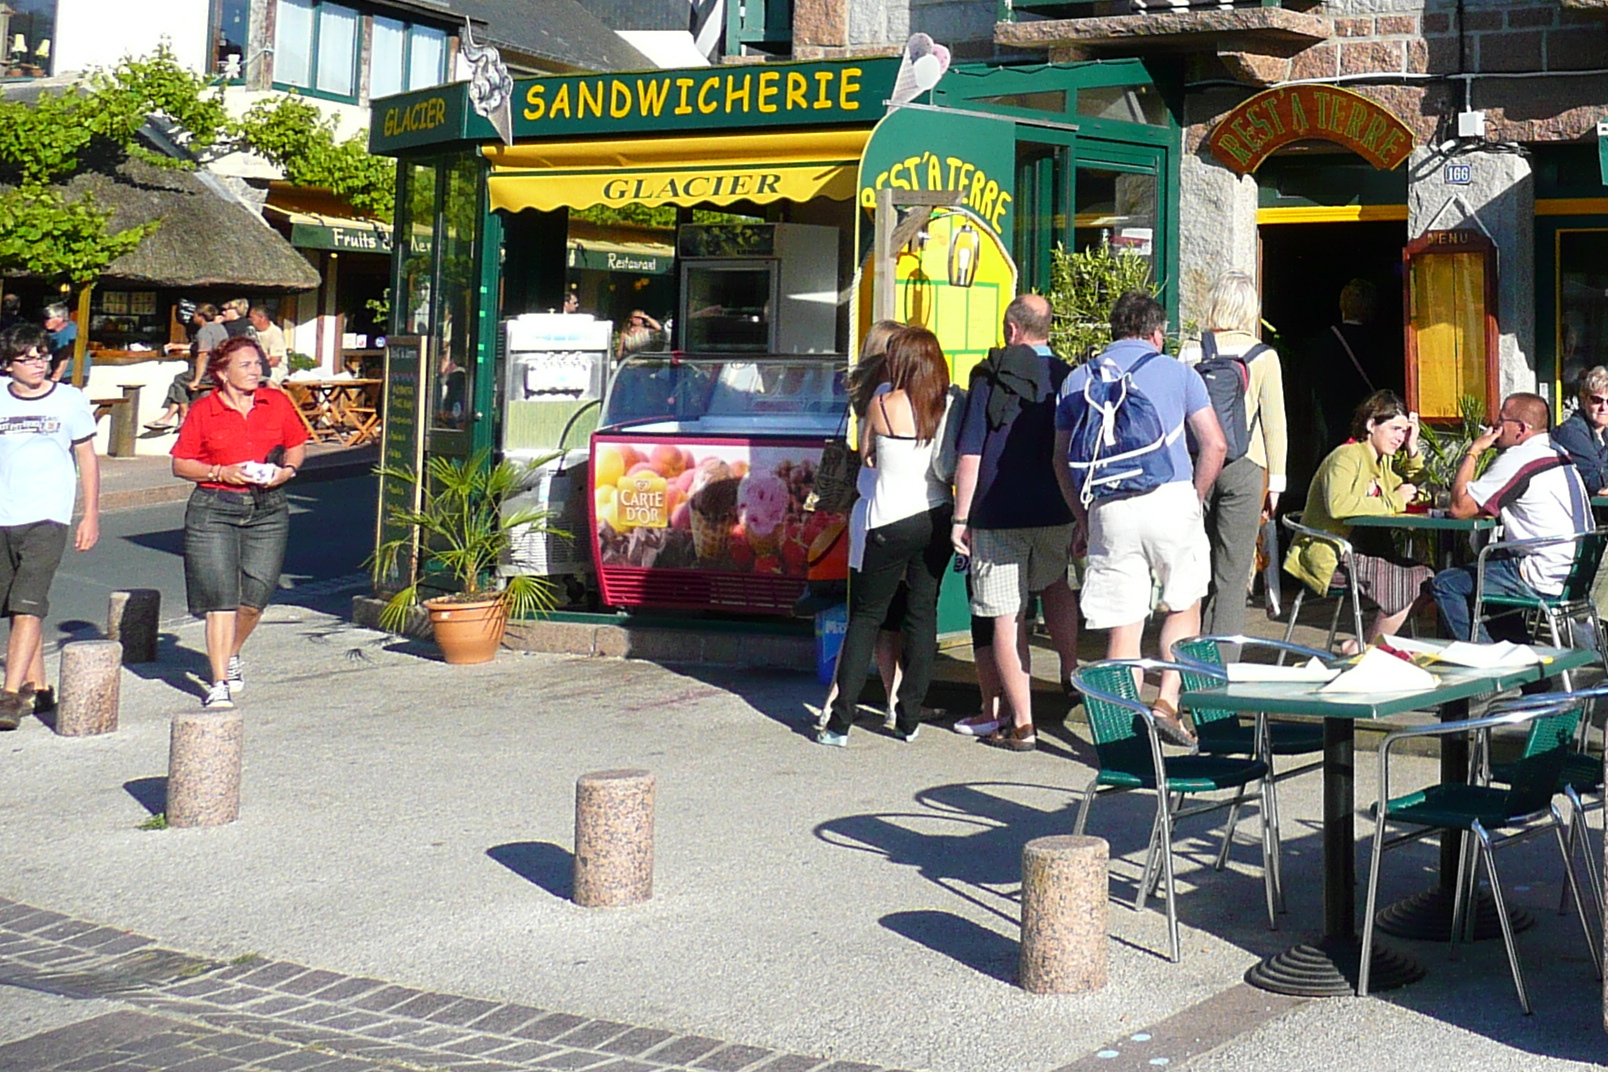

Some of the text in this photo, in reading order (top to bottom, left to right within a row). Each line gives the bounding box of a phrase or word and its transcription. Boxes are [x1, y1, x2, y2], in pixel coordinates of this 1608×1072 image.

[522, 67, 863, 121] SANDWICHERIE
[383, 97, 446, 138] GLACIER
[1218, 90, 1406, 166] REST'A TERRE
[1447, 166, 1469, 181] 166
[602, 173, 782, 201] GLACIER
[946, 156, 1013, 235] TERRE
[331, 227, 377, 249] Fruits
[1427, 231, 1468, 246] MENU
[607, 251, 657, 271] Restaurant
[620, 488, 664, 508] CARTE
[626, 505, 660, 525] D'OR
